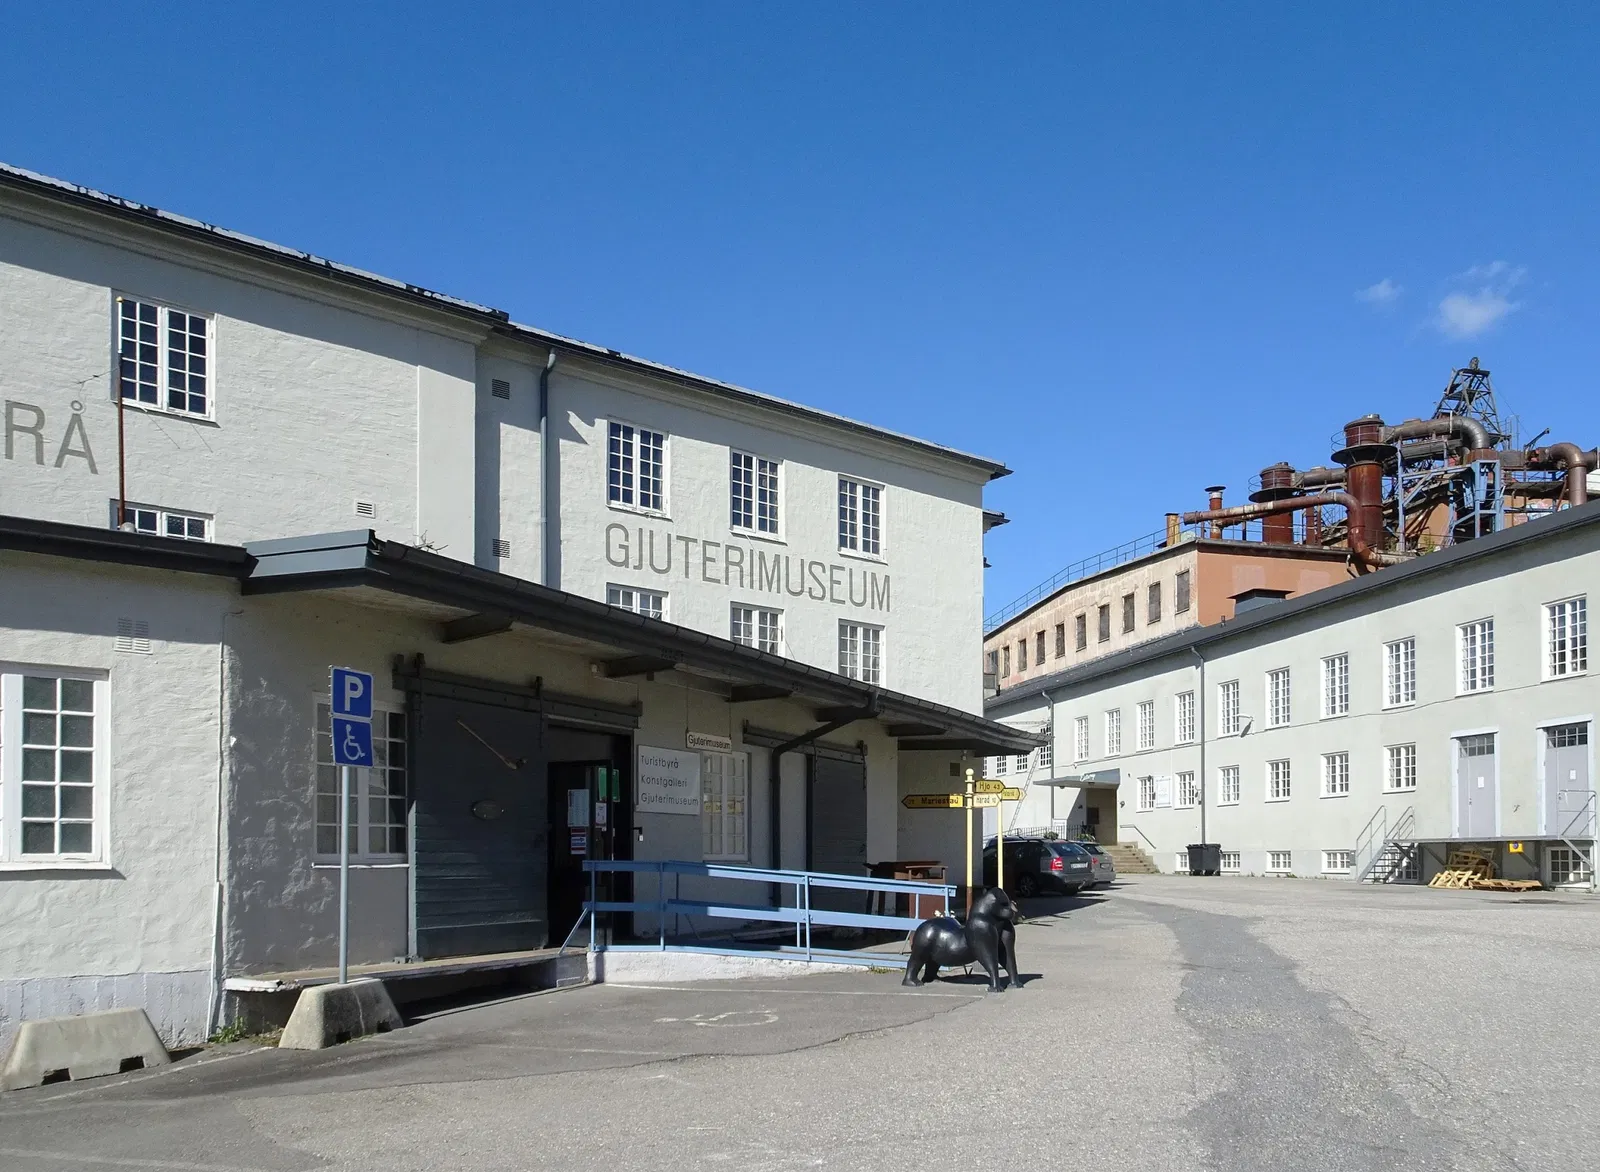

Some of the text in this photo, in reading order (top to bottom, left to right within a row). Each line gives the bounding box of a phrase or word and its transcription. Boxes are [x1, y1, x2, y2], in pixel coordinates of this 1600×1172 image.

[5, 400, 99, 475] RÅ
[605, 522, 891, 612] GJUTERIMUSEUM
[345, 674, 364, 711] P
[688, 734, 731, 749] Gjuterimuseum
[640, 755, 679, 769] Turistbyrå
[640, 774, 688, 788] Konstgalleri
[640, 792, 699, 807] Gjuterimuseum
